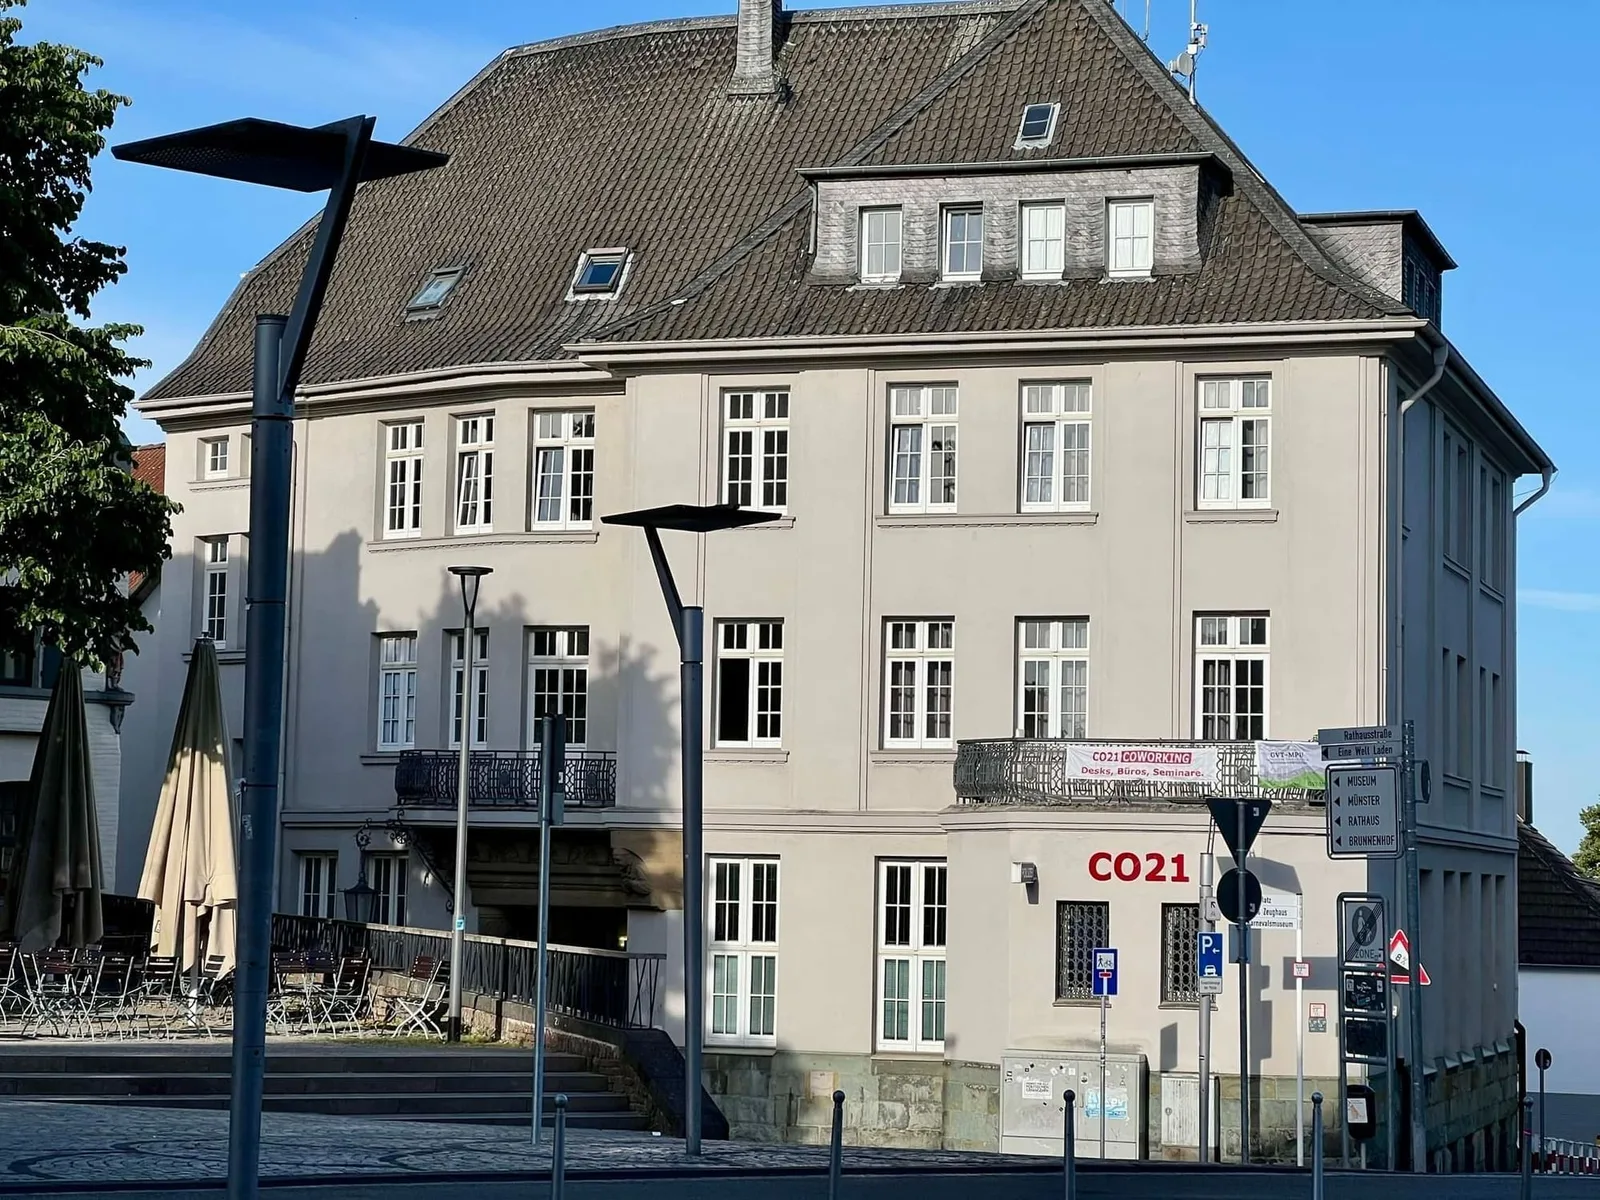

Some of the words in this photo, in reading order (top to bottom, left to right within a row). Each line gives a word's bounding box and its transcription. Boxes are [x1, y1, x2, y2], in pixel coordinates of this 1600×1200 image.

[1344, 729, 1392, 740] Rathausstraße
[1338, 747, 1351, 756] Eine
[1355, 745, 1370, 755] Welt
[1373, 744, 1393, 755] Laden
[1092, 752, 1119, 761] CO21
[1122, 751, 1190, 763] COWORKING
[1081, 766, 1114, 775] Desks,
[1117, 767, 1150, 776] Büros,
[1153, 768, 1204, 777] Seminare.
[1347, 775, 1377, 787] MUSEUM
[1347, 794, 1381, 806] MÜNSTER
[1348, 815, 1380, 827] RATHAUS
[1349, 834, 1395, 846] BRUNNENHOF
[1088, 852, 1189, 882] CO21
[1263, 908, 1288, 917] Zeughaus
[1249, 920, 1293, 928] arnevalsmuseum
[1202, 935, 1213, 954] P
[1355, 948, 1376, 959] ZONE
